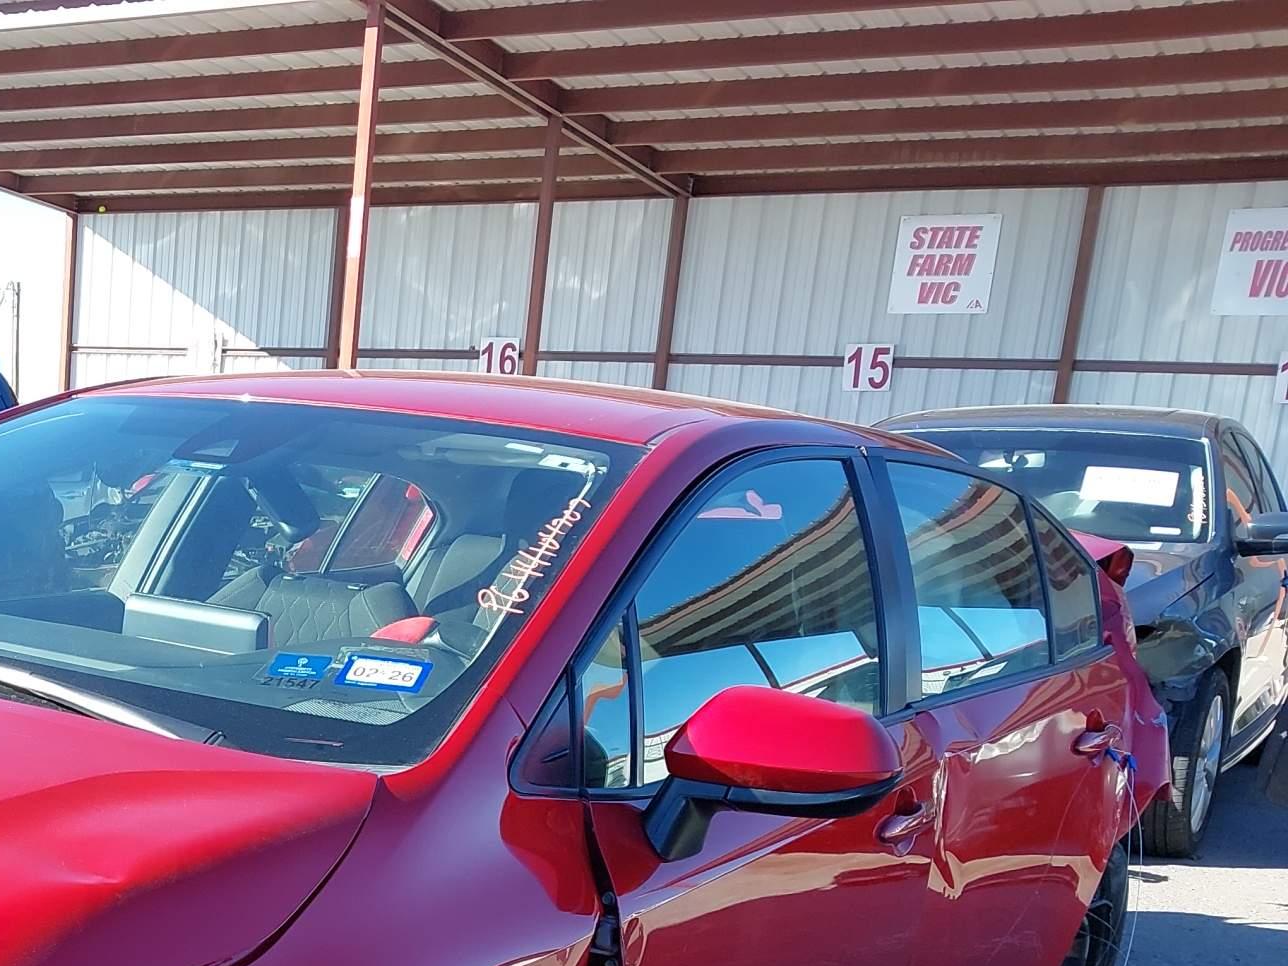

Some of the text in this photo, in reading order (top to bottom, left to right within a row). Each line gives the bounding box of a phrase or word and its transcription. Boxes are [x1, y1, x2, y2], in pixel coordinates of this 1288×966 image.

[909, 226, 984, 250] STATE
[906, 253, 977, 277] FARM
[917, 281, 962, 305] VIC
[481, 341, 517, 375] 16
[847, 346, 891, 389] 15
